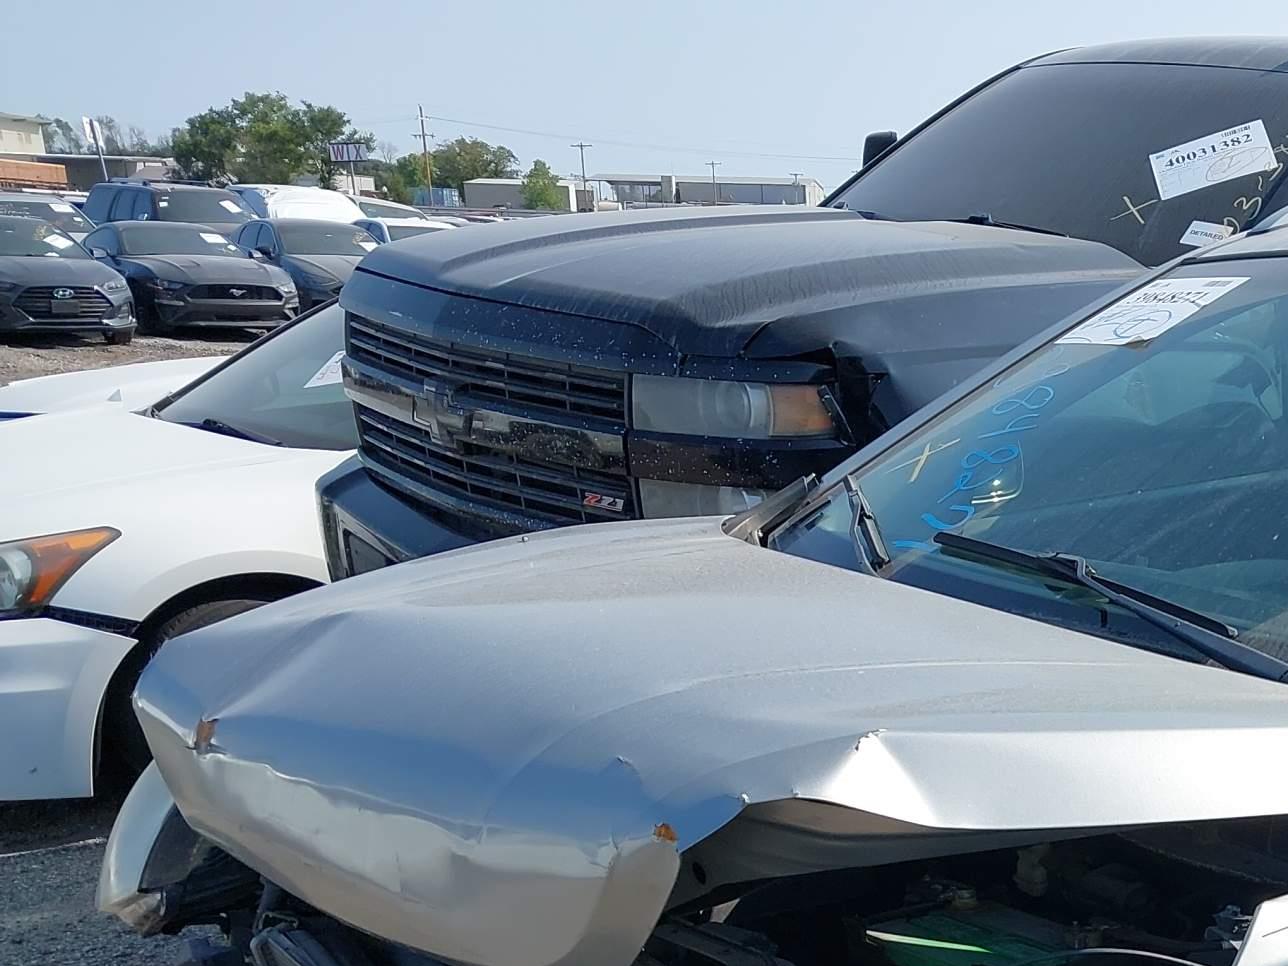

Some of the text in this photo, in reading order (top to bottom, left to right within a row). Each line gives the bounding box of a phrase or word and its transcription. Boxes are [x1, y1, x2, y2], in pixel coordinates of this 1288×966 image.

[332, 144, 363, 161] WIX
[1164, 133, 1253, 168] 40031382
[1190, 229, 1225, 241] DETAILED
[583, 491, 625, 511] Z71
